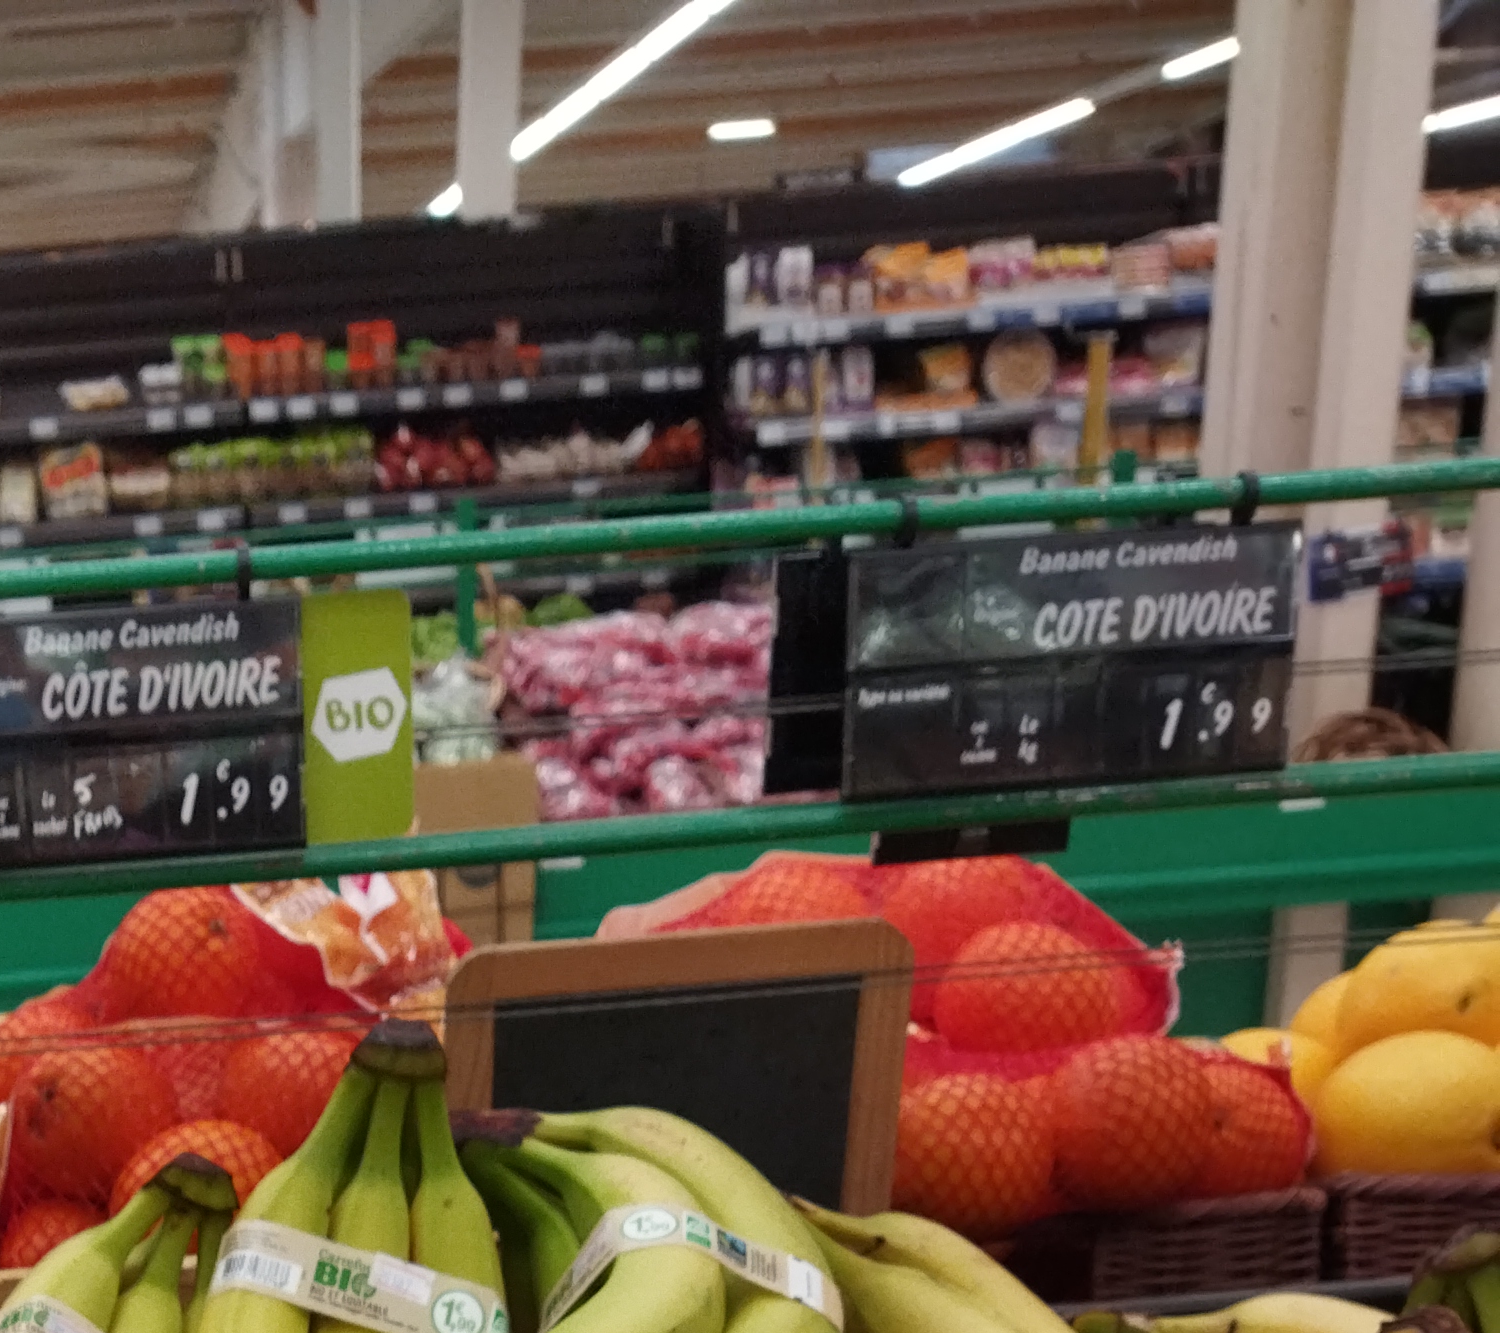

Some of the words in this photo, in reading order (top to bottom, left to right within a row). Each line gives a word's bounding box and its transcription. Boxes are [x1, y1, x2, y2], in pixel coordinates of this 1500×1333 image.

[1021, 545, 1103, 575] Banane
[1117, 535, 1239, 569] Cavendish
[24, 621, 113, 657] Banane
[119, 612, 239, 650] Cavendish
[1131, 586, 1278, 643] D'IVOIRE
[42, 659, 128, 721] CÔTE
[138, 656, 283, 715] D'IVOIRE
[325, 696, 395, 734] BIO
